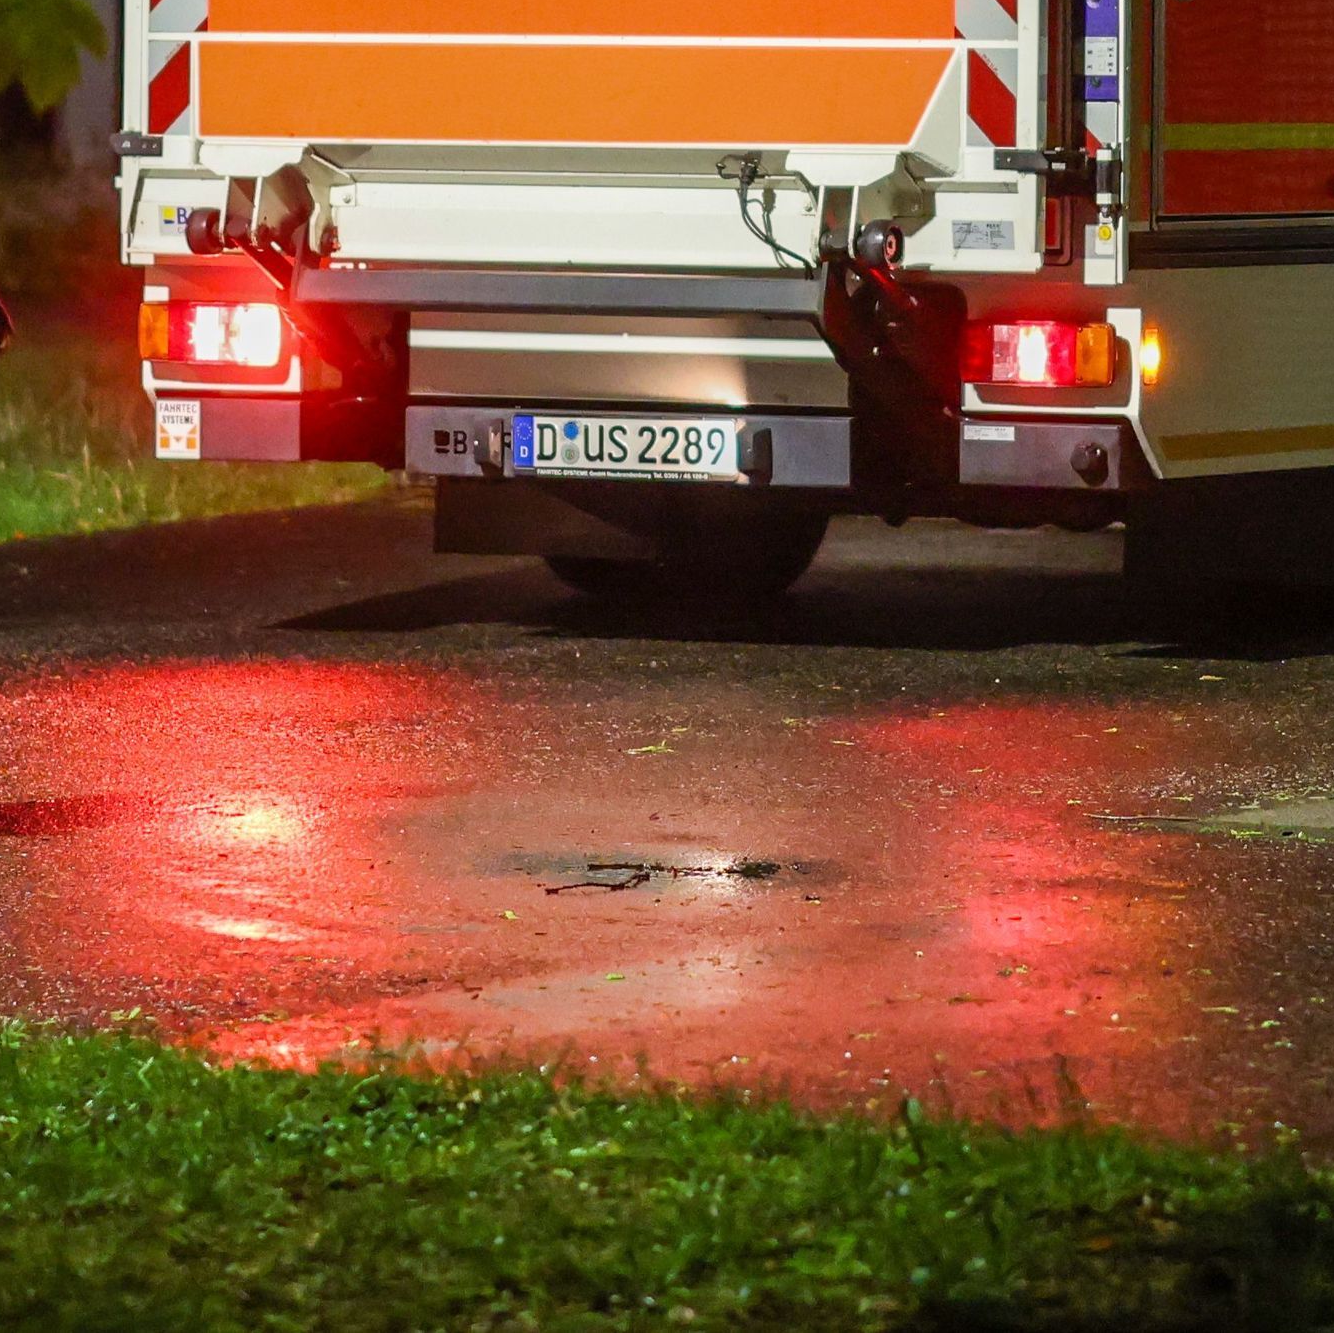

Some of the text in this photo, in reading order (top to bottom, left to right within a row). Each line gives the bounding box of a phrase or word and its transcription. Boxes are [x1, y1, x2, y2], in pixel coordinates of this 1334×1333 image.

[159, 402, 198, 414] FAHRTEC
[162, 415, 195, 425] SYSTEME
[536, 423, 727, 466] D US 2289
[519, 446, 529, 459] D
